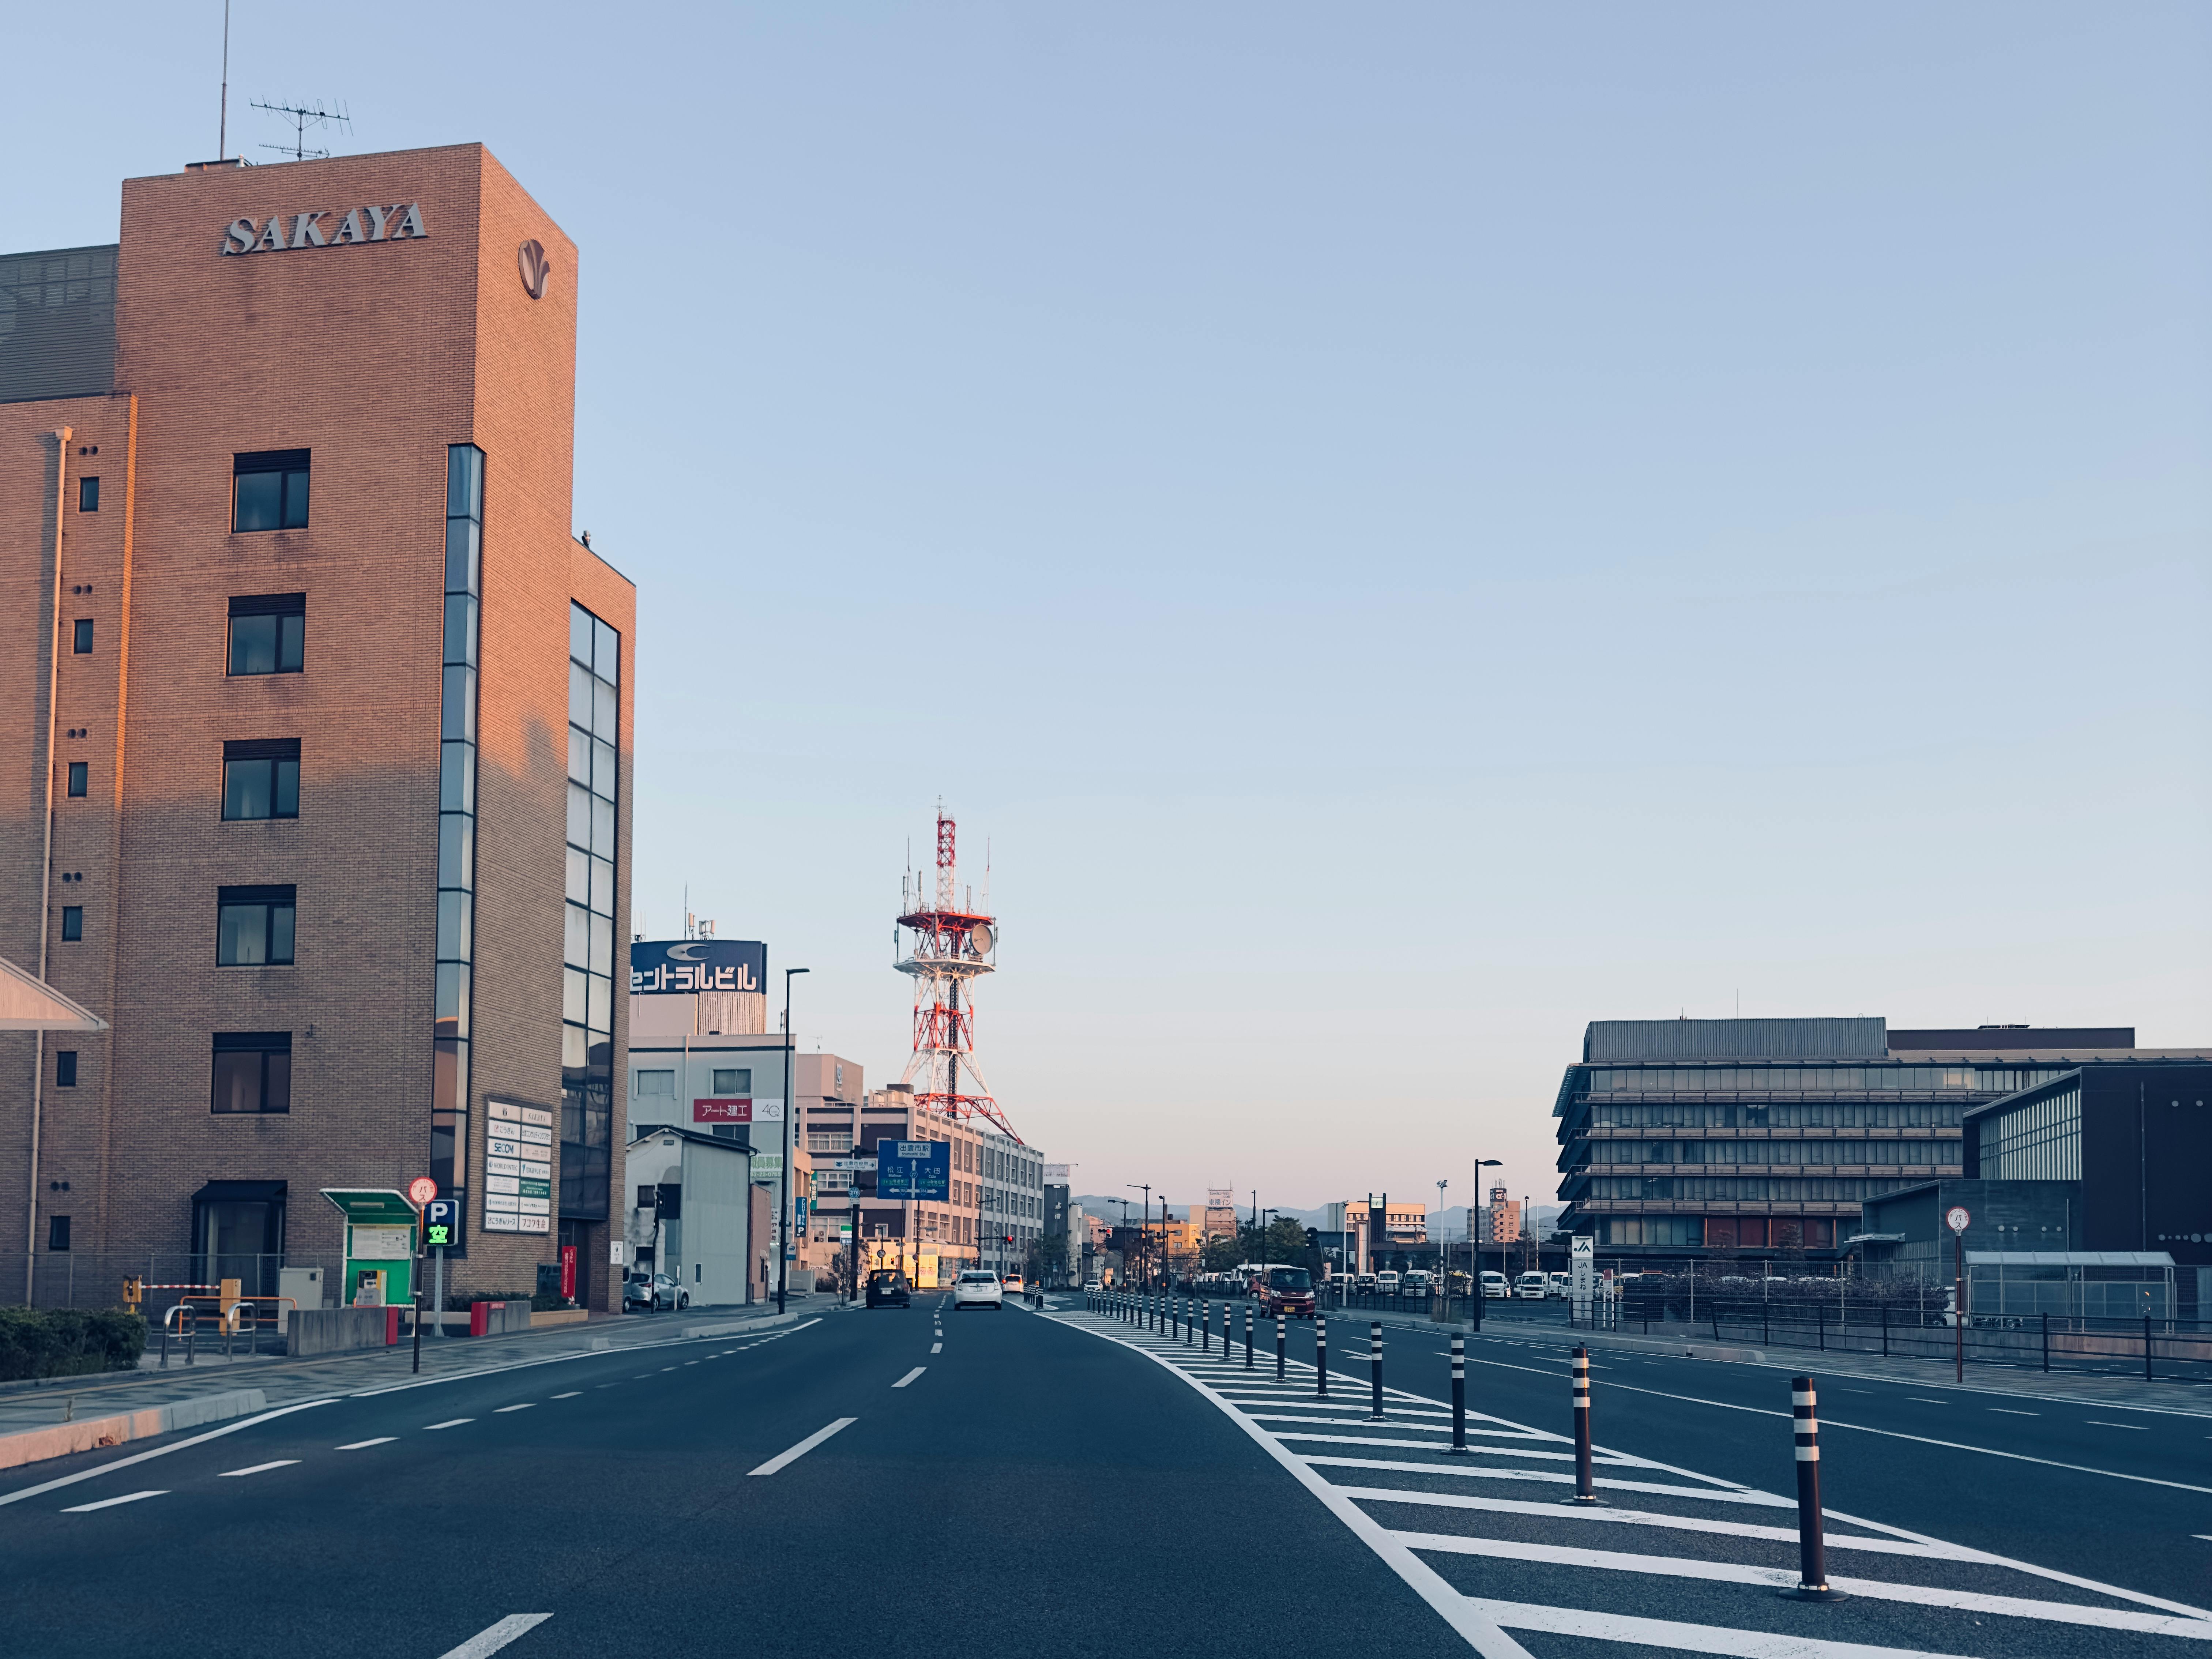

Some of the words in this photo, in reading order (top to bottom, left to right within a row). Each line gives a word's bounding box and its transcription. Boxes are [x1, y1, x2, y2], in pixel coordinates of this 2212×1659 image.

[222, 202, 427, 255] SAKAYA
[630, 963, 756, 991] セントラルビル
[702, 1105, 747, 1116] アート建工
[494, 1143, 514, 1154] SECOM
[430, 1203, 448, 1222] P
[522, 1218, 546, 1229] フコク生命
[1955, 1215, 1962, 1228] バス
[429, 1224, 448, 1244] 空
